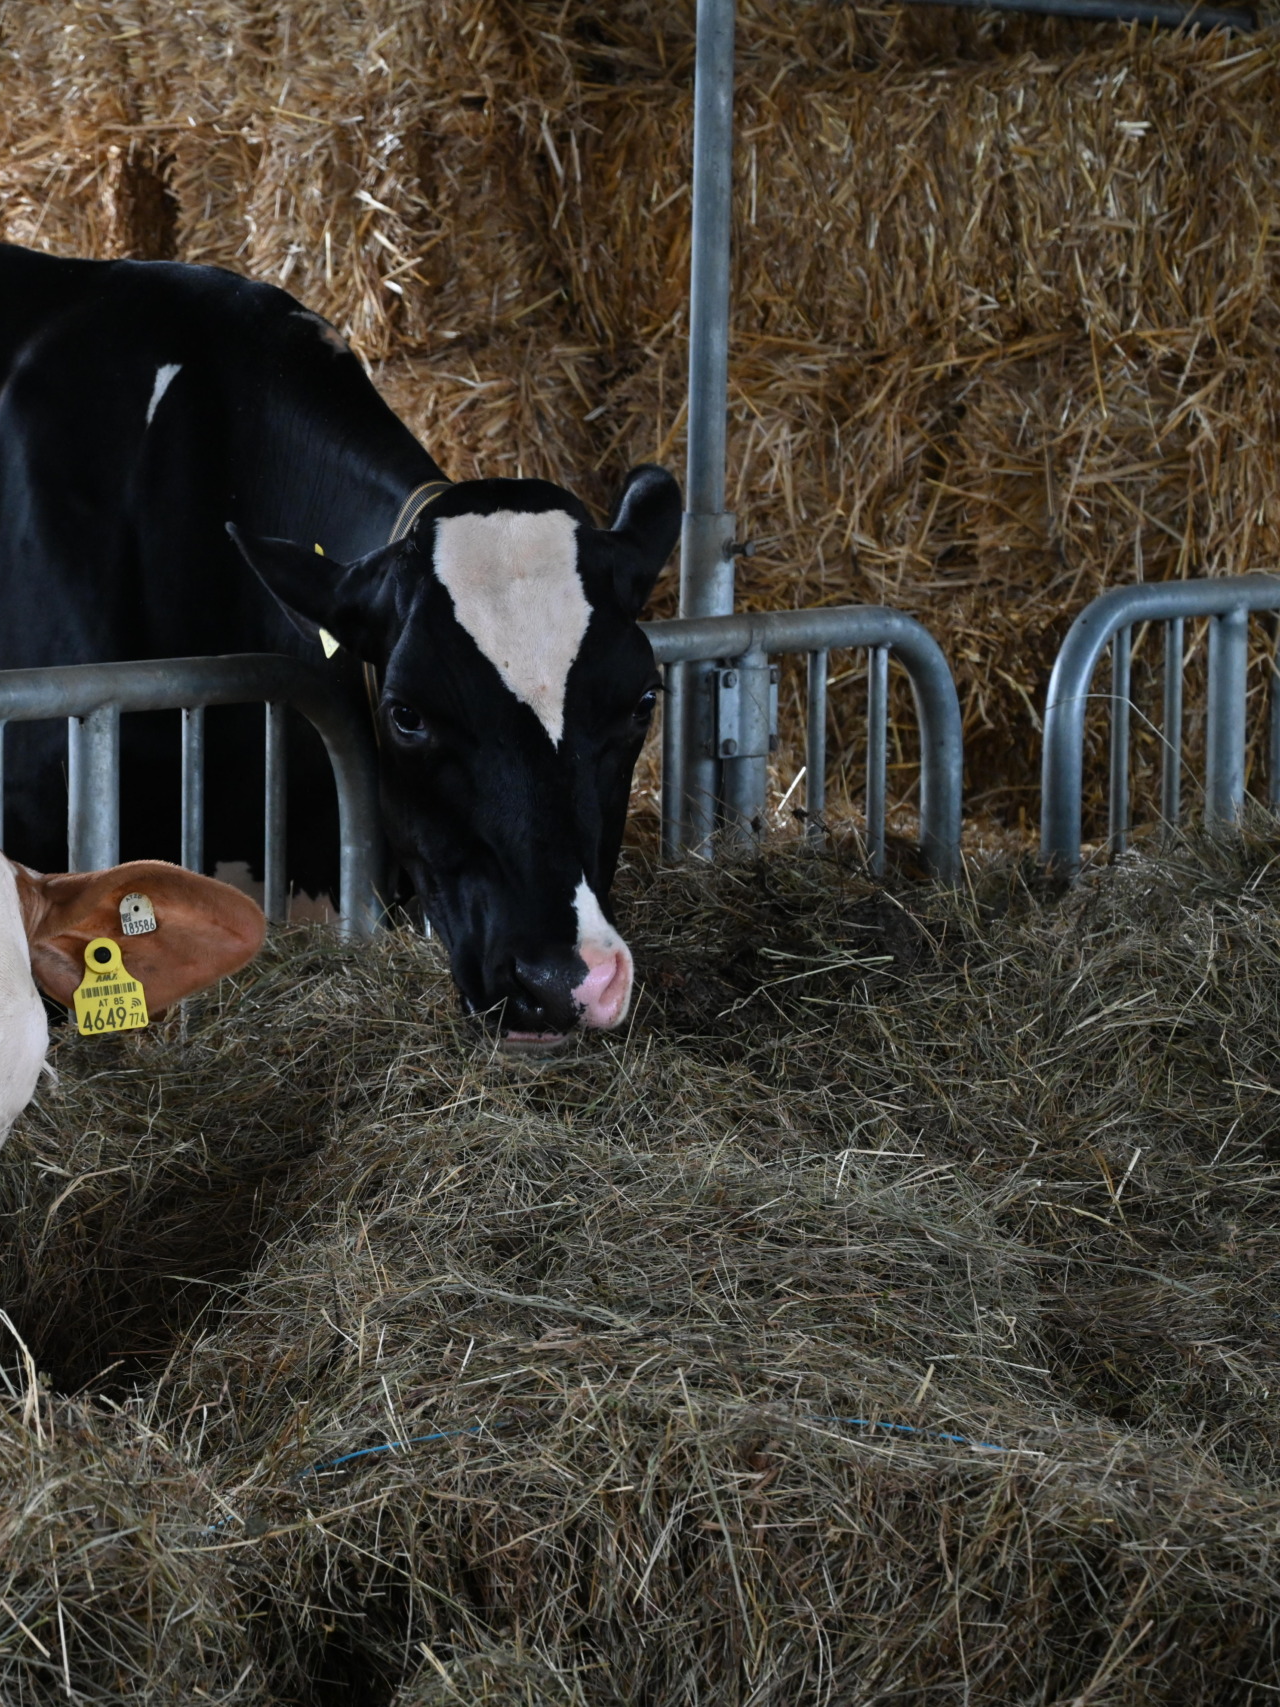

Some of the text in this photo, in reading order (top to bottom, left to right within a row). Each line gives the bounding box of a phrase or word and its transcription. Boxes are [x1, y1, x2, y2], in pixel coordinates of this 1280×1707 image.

[123, 917, 155, 935] 183586
[98, 996, 125, 1007] AT 85
[83, 1006, 146, 1032] 4649 774
